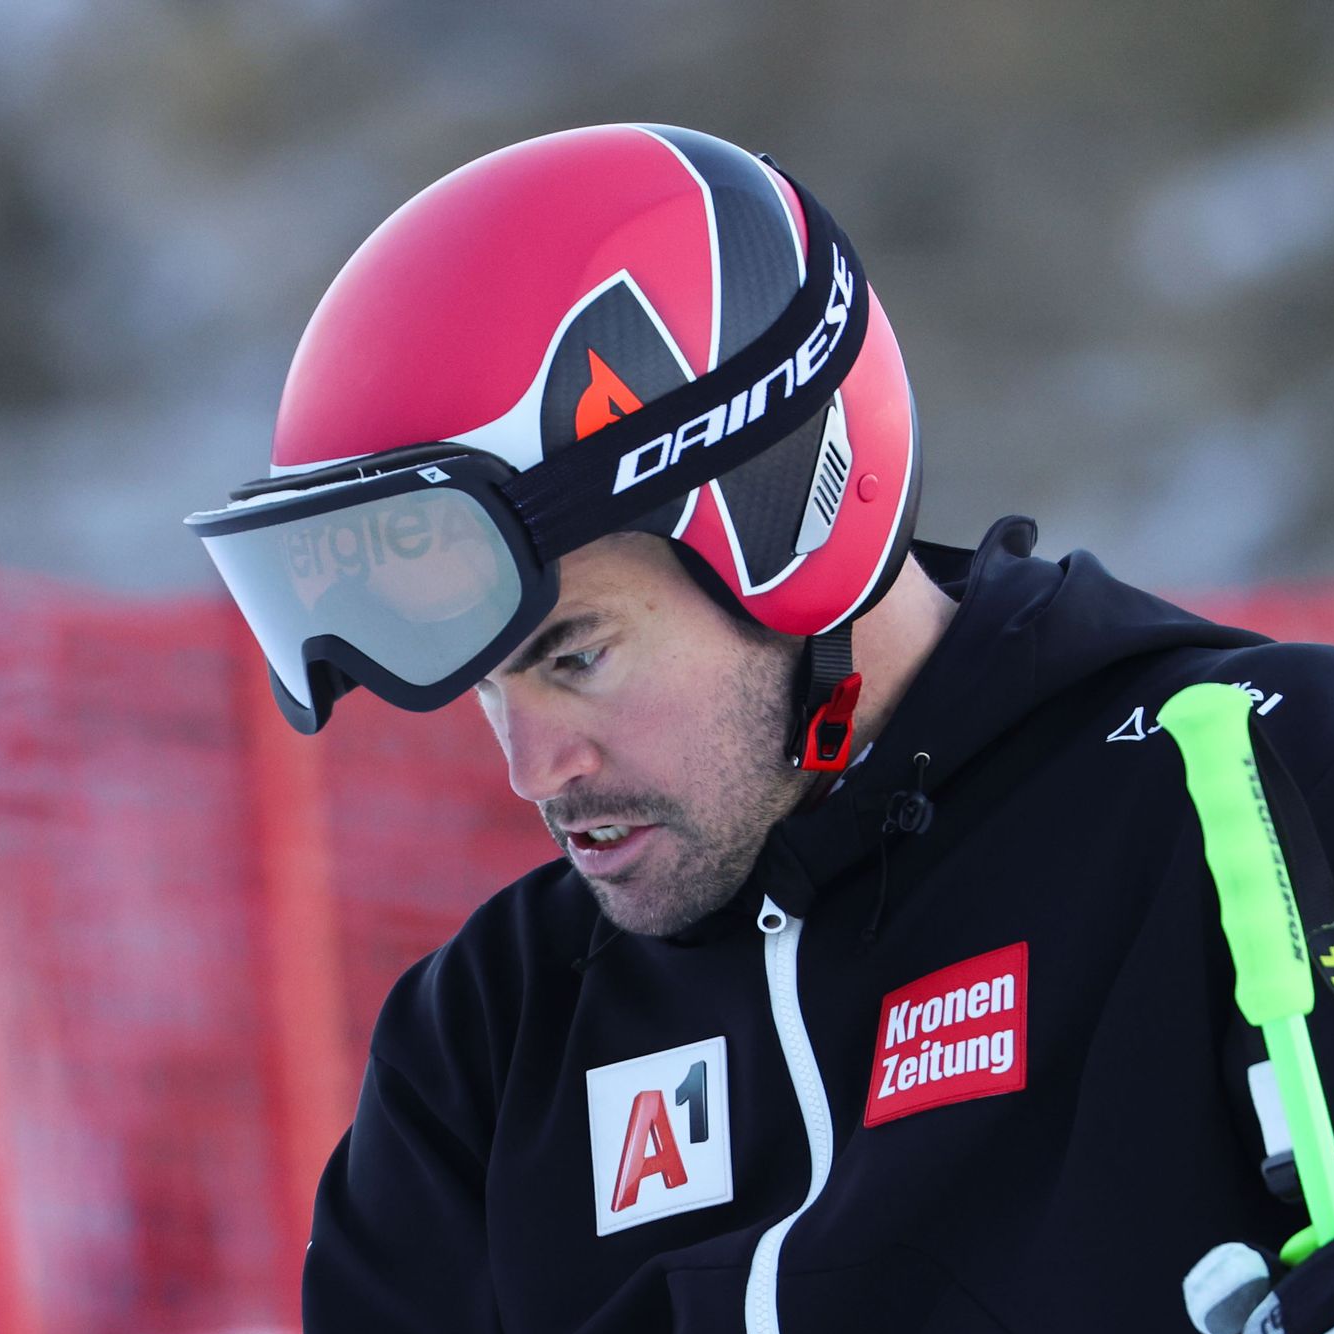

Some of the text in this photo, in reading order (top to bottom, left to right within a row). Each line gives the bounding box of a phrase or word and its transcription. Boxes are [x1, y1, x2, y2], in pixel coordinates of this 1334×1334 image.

[612, 242, 854, 493] DAINESE
[878, 1029, 1014, 1099] Zeitung
[885, 973, 1014, 1049] Kronen
[611, 1060, 709, 1212] A1
